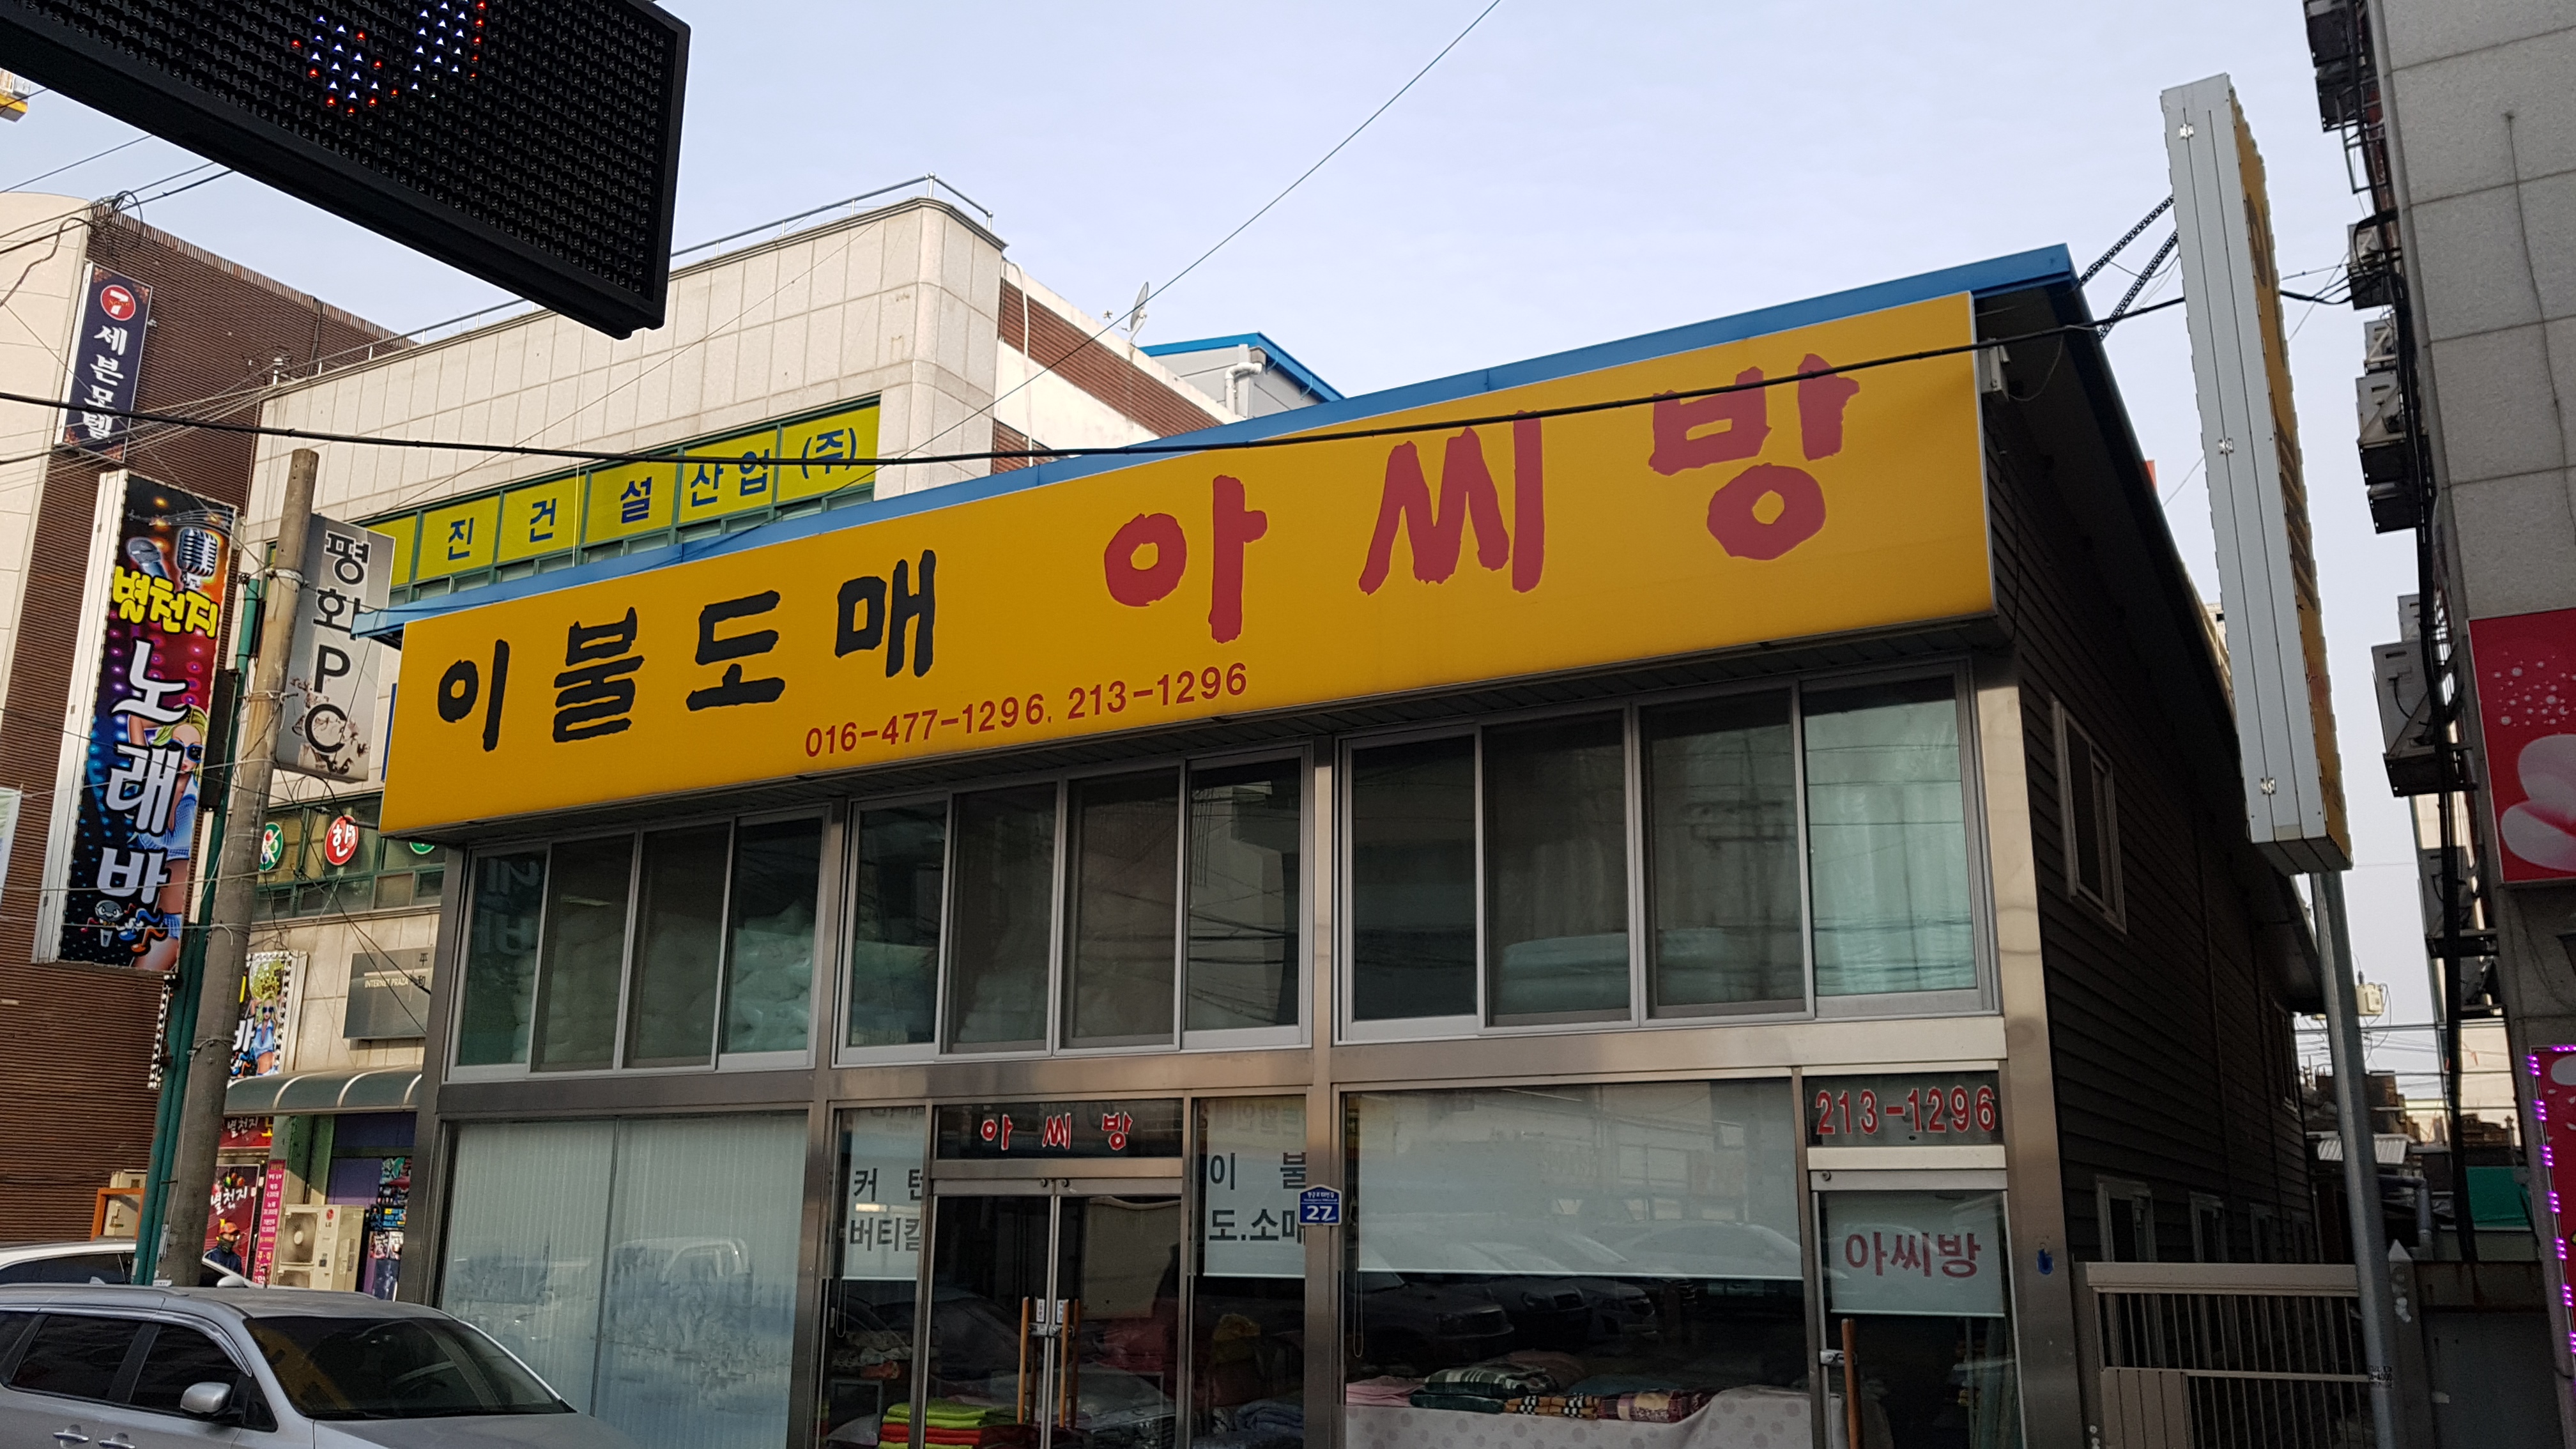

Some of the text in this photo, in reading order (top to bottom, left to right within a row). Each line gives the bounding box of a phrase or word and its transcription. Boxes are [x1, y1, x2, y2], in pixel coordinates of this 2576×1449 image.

[82, 325, 128, 441] 세븐모텔
[437, 353, 1860, 753] 이불도매 아씨방
[112, 566, 220, 638] 별천지
[1068, 662, 1248, 720] 213-1296
[96, 639, 190, 905] 노래바
[980, 1110, 1135, 1151] 아씨방
[1815, 1085, 1997, 1135] 213-1296
[210, 1185, 248, 1215] 별천지
[1307, 1205, 1333, 1221] 27
[1845, 1232, 1981, 1278] 아씨방
